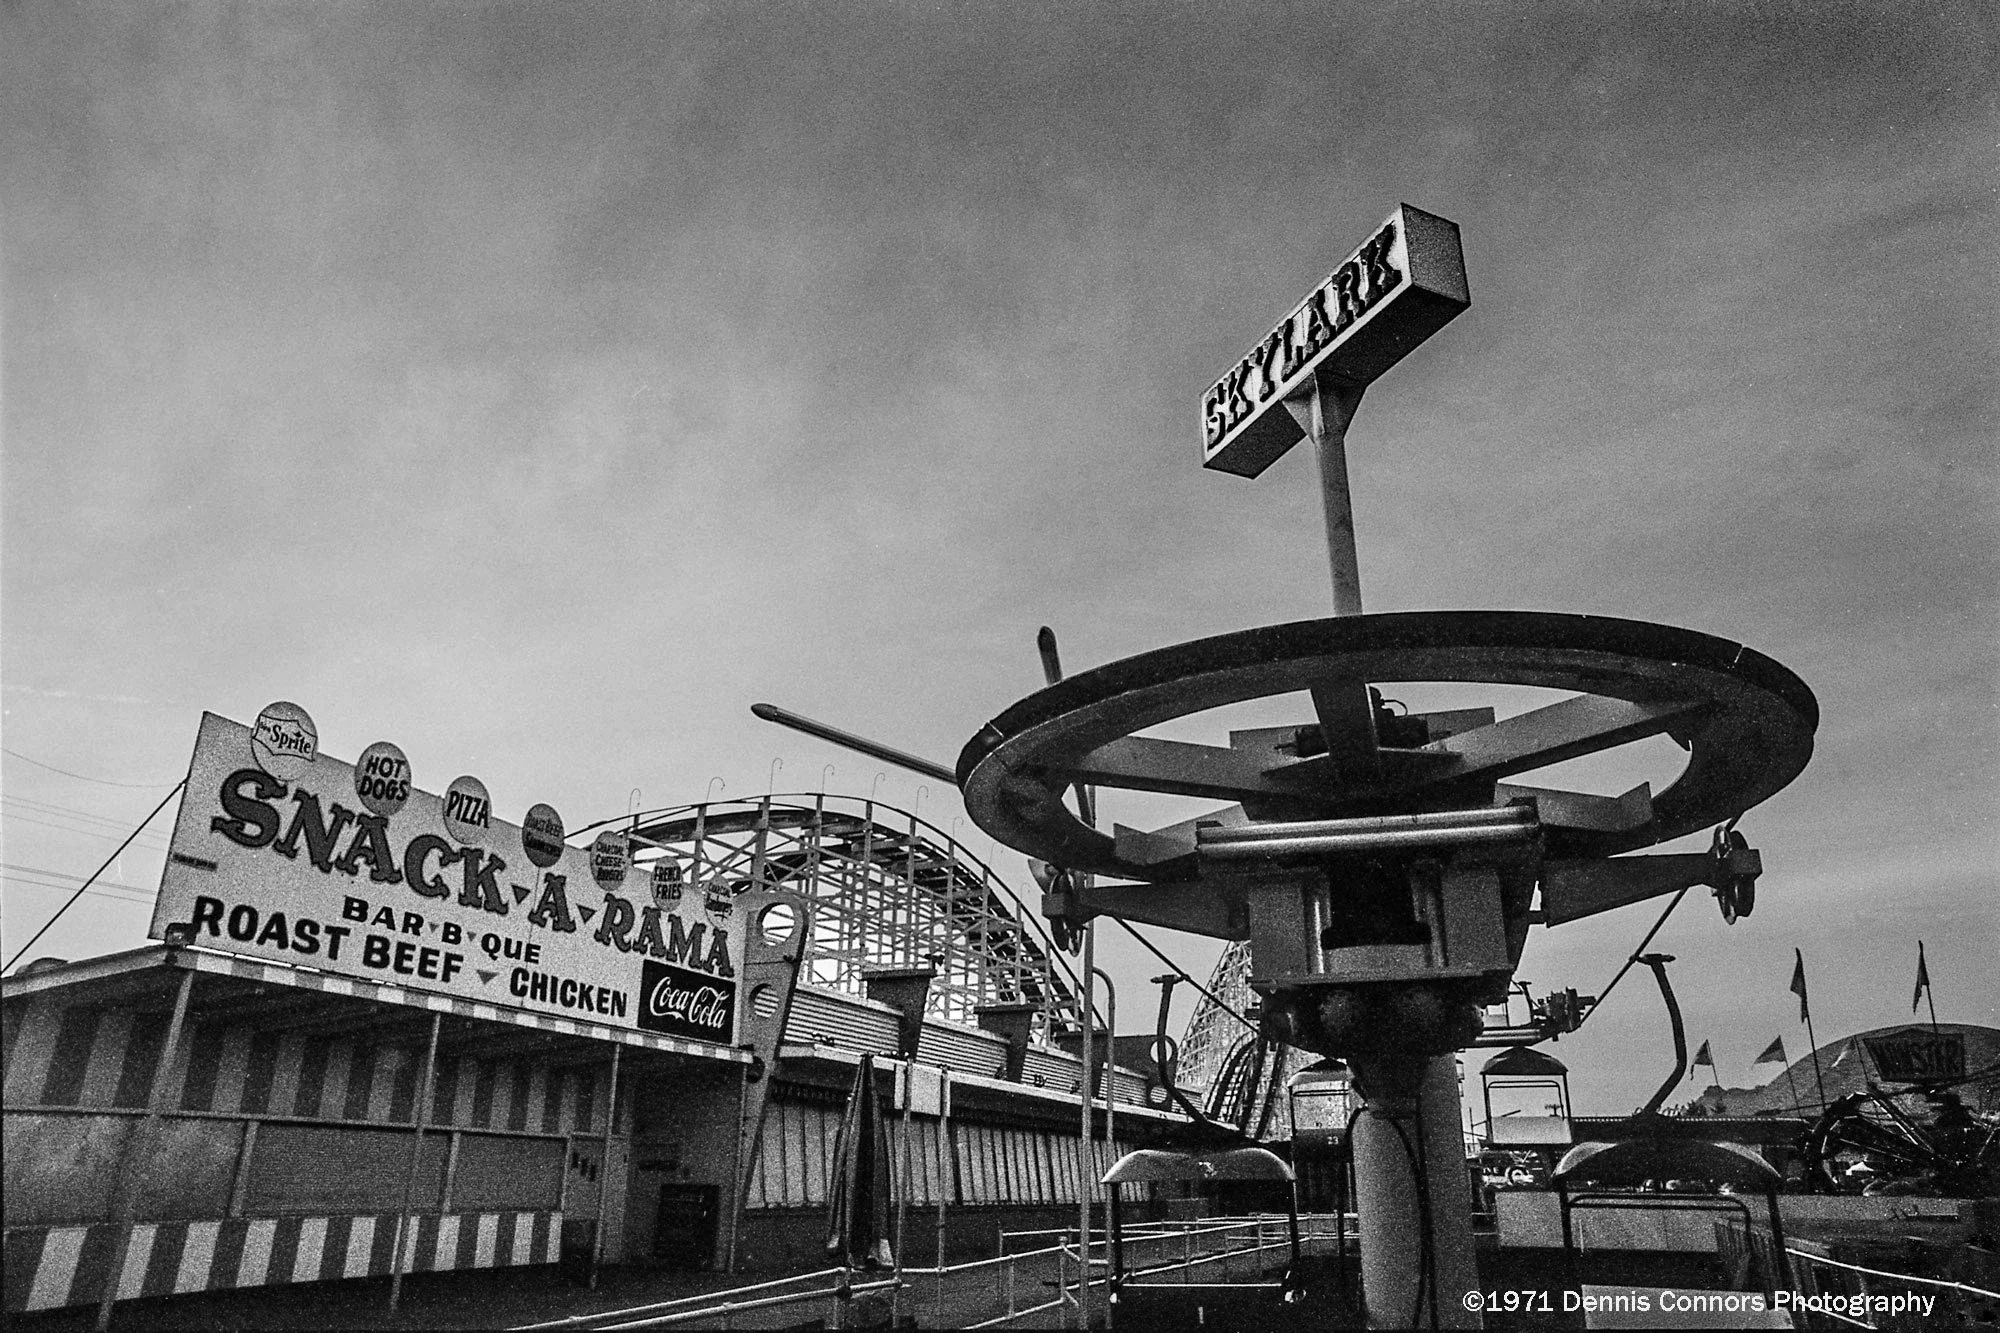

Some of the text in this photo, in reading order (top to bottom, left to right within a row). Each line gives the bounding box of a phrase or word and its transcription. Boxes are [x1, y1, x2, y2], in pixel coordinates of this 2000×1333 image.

[1206, 221, 1403, 451] SKYLARK
[270, 724, 312, 754] Sprite
[366, 755, 406, 779] HOT
[358, 778, 410, 801] DOGS
[446, 790, 490, 829] PIZZA
[654, 866, 681, 881] FRENCH
[656, 883, 682, 900] FRIES
[191, 896, 464, 983] ROAST BEEF
[510, 968, 627, 1017] CHICKEN
[650, 976, 729, 1029] Coca-Cola
